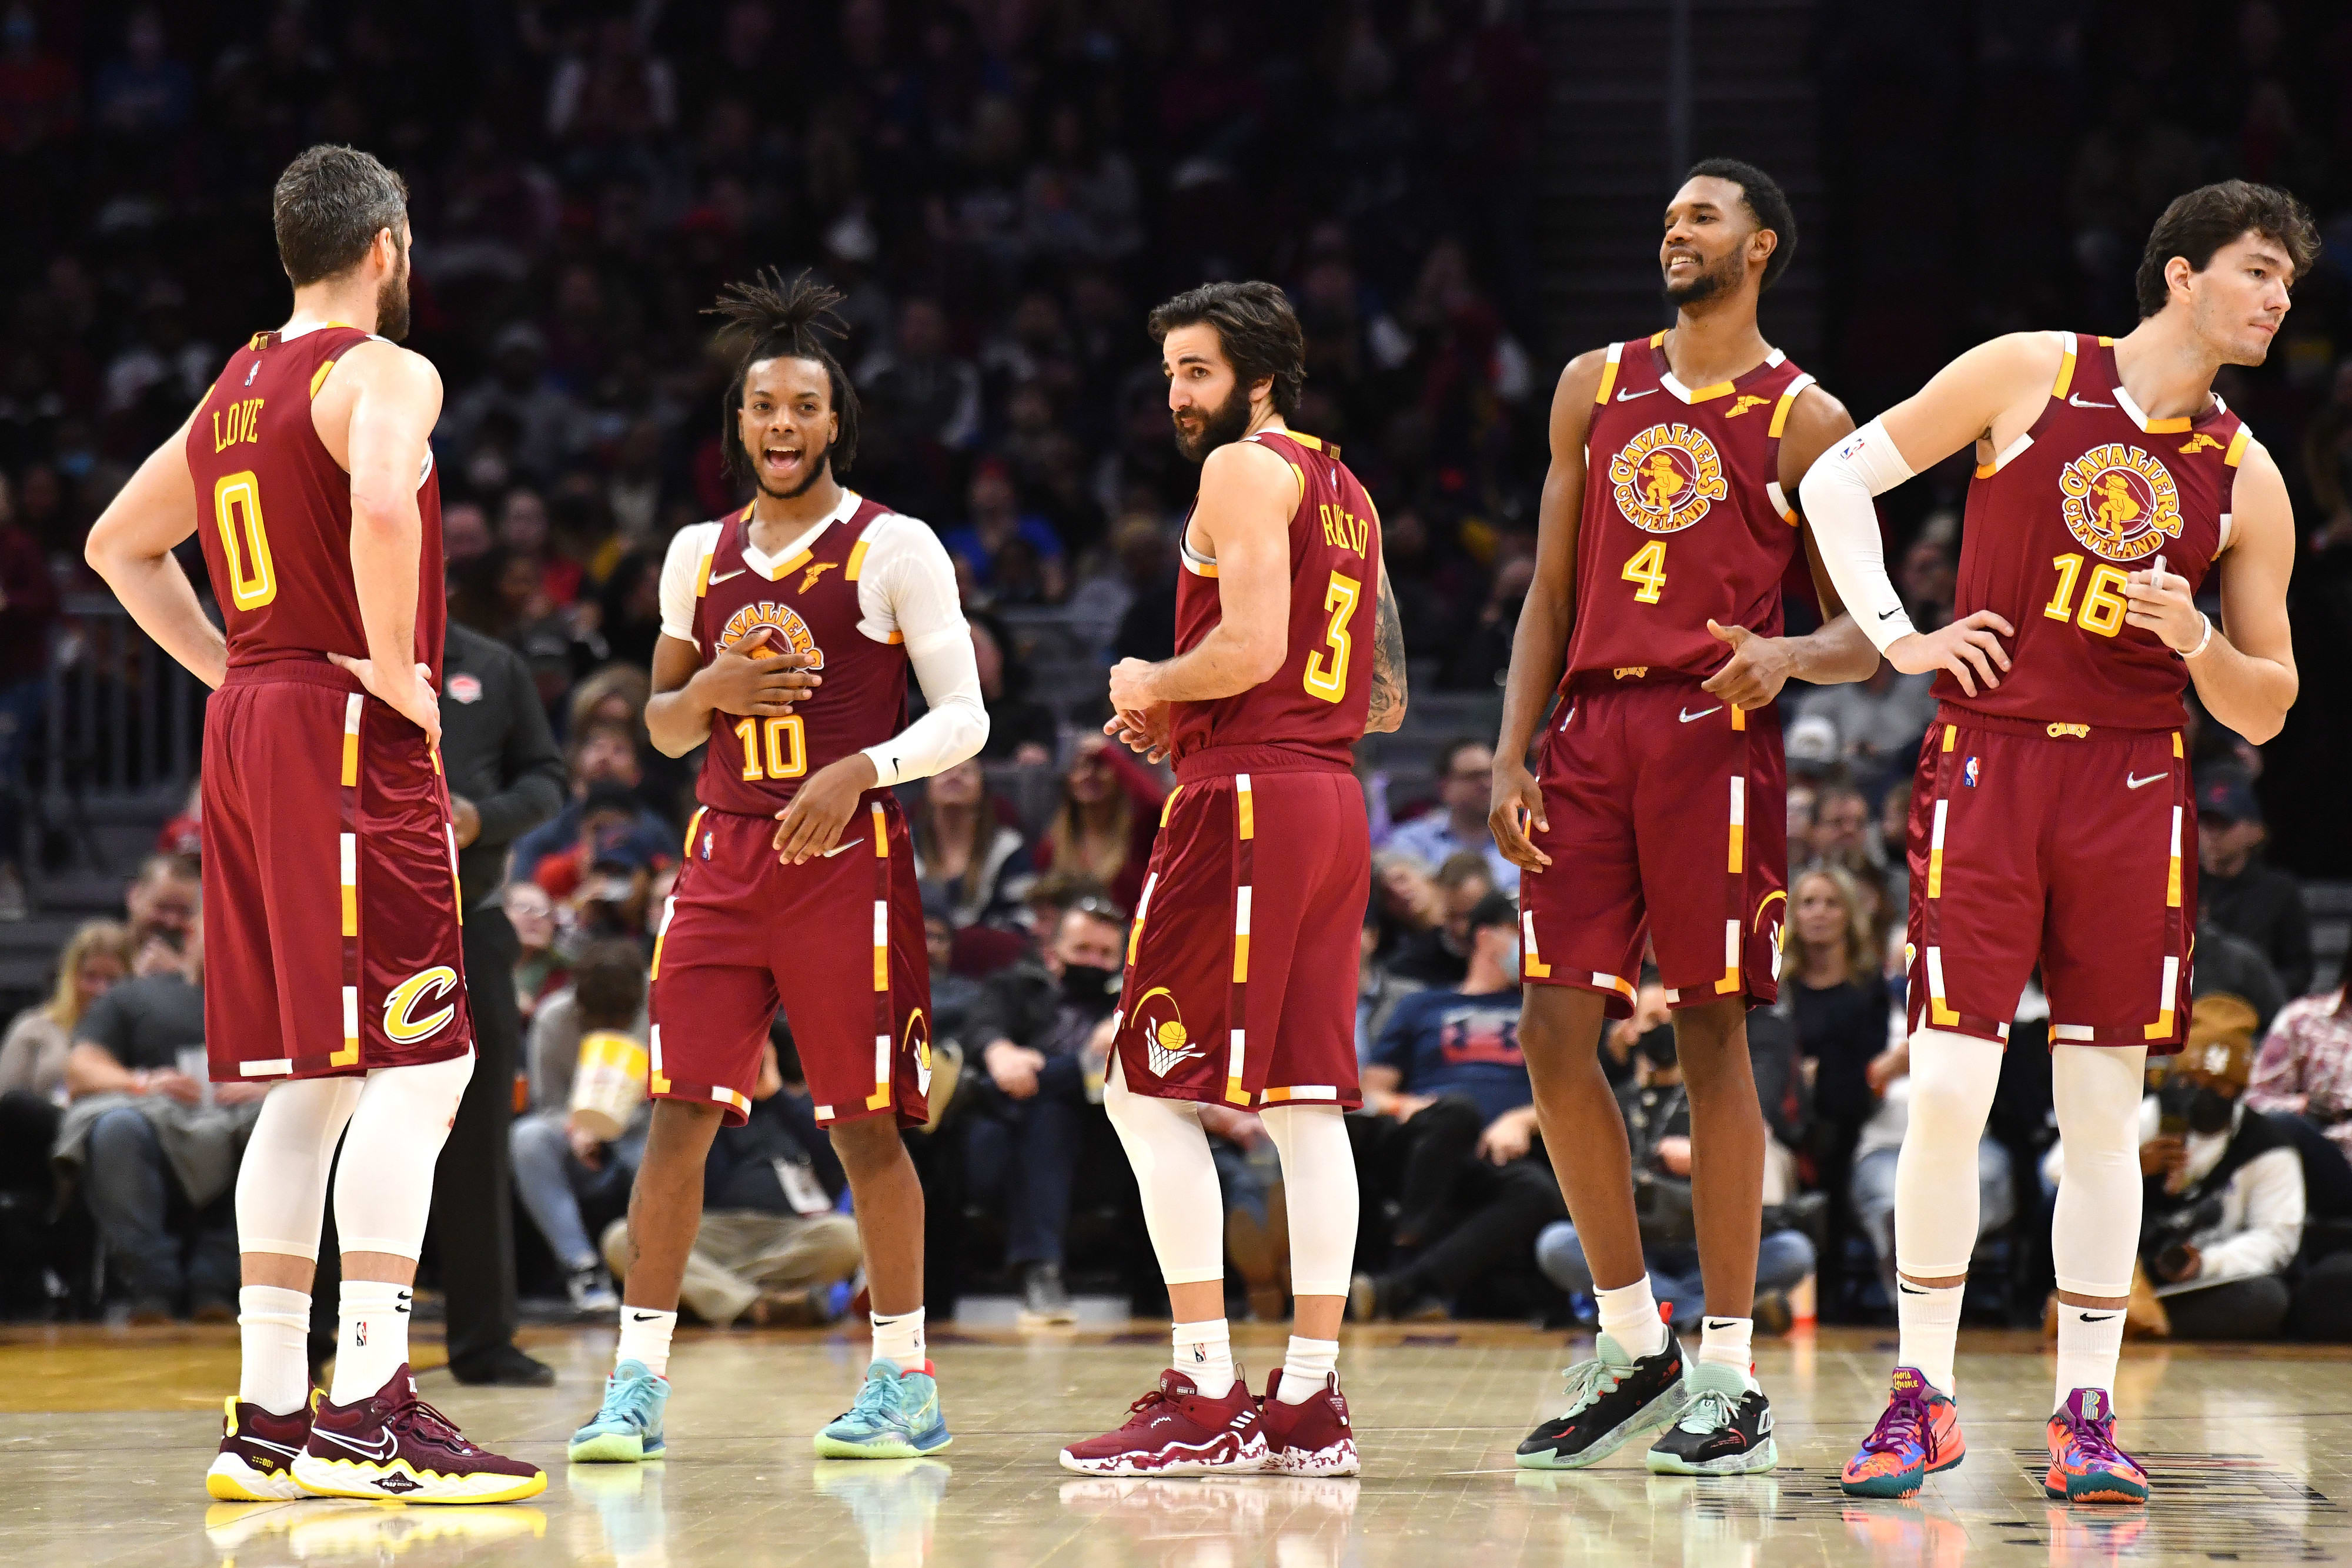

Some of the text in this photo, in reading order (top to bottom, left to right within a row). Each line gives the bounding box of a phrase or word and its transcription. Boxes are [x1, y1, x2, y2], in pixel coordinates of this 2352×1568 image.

[213, 398, 265, 454] LOVE
[1610, 423, 1727, 500] CAVALIERS
[2060, 444, 2183, 538] CAVALIERS
[215, 470, 277, 611] 0
[1615, 485, 1710, 533] CLEVELAND
[2063, 497, 2164, 560] CLEVELAND
[1622, 540, 1667, 605] 4
[2044, 553, 2129, 637] 16
[716, 603, 824, 670] AVALIERS
[1303, 570, 1361, 704] 3
[735, 716, 808, 781] 10
[2046, 721, 2091, 738] CAVS
[383, 965, 458, 1045] C
